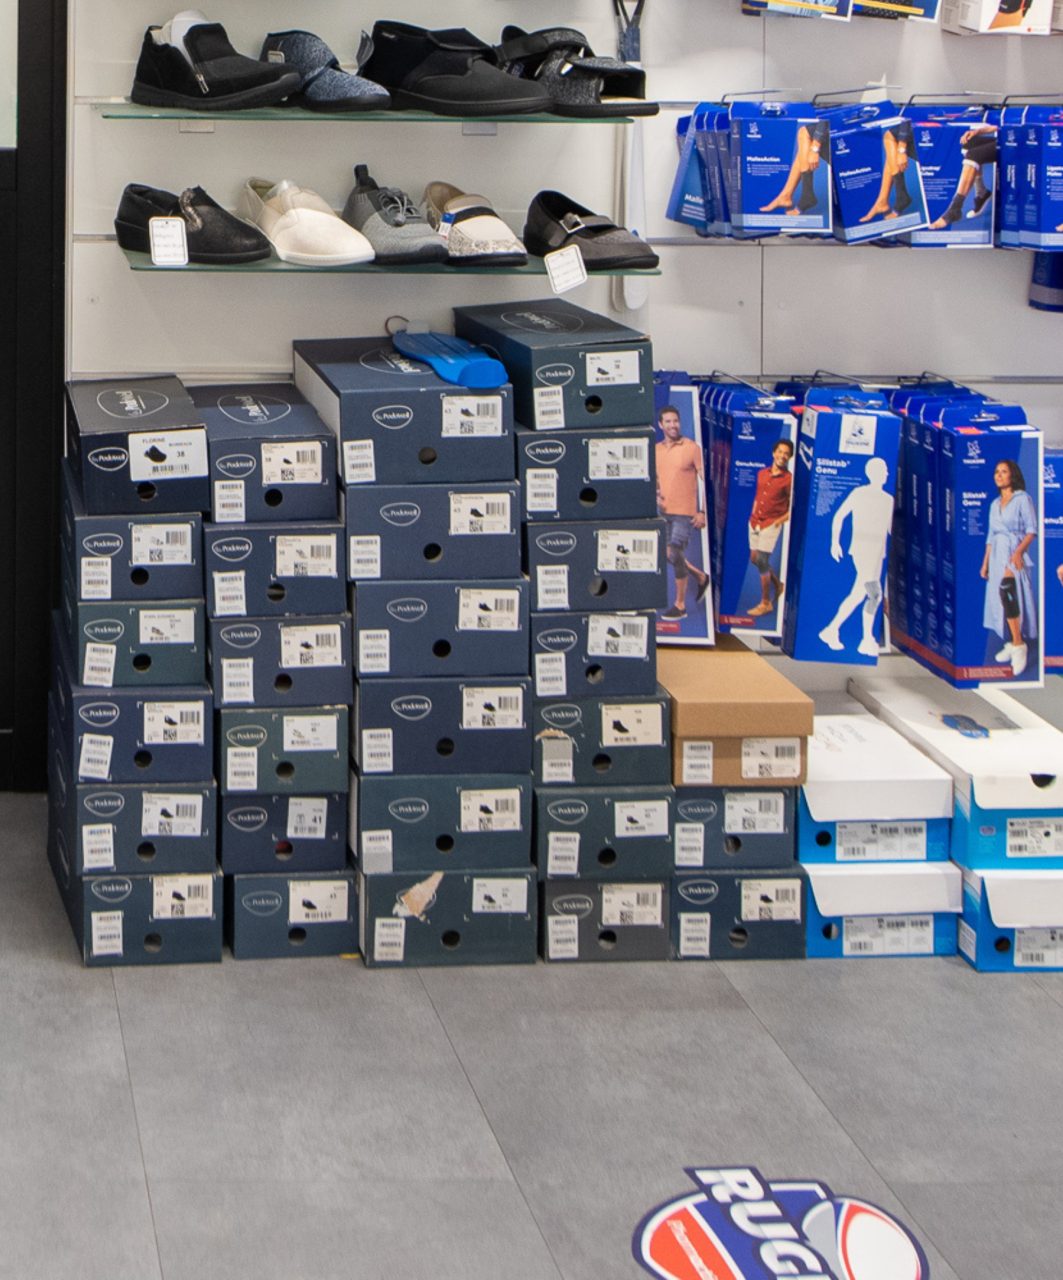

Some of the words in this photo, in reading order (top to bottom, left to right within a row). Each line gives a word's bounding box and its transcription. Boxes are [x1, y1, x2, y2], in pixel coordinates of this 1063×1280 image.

[685, 194, 704, 204] Malle
[816, 466, 837, 475] Genu
[312, 815, 321, 823] 41
[694, 1168, 835, 1280] RUG
